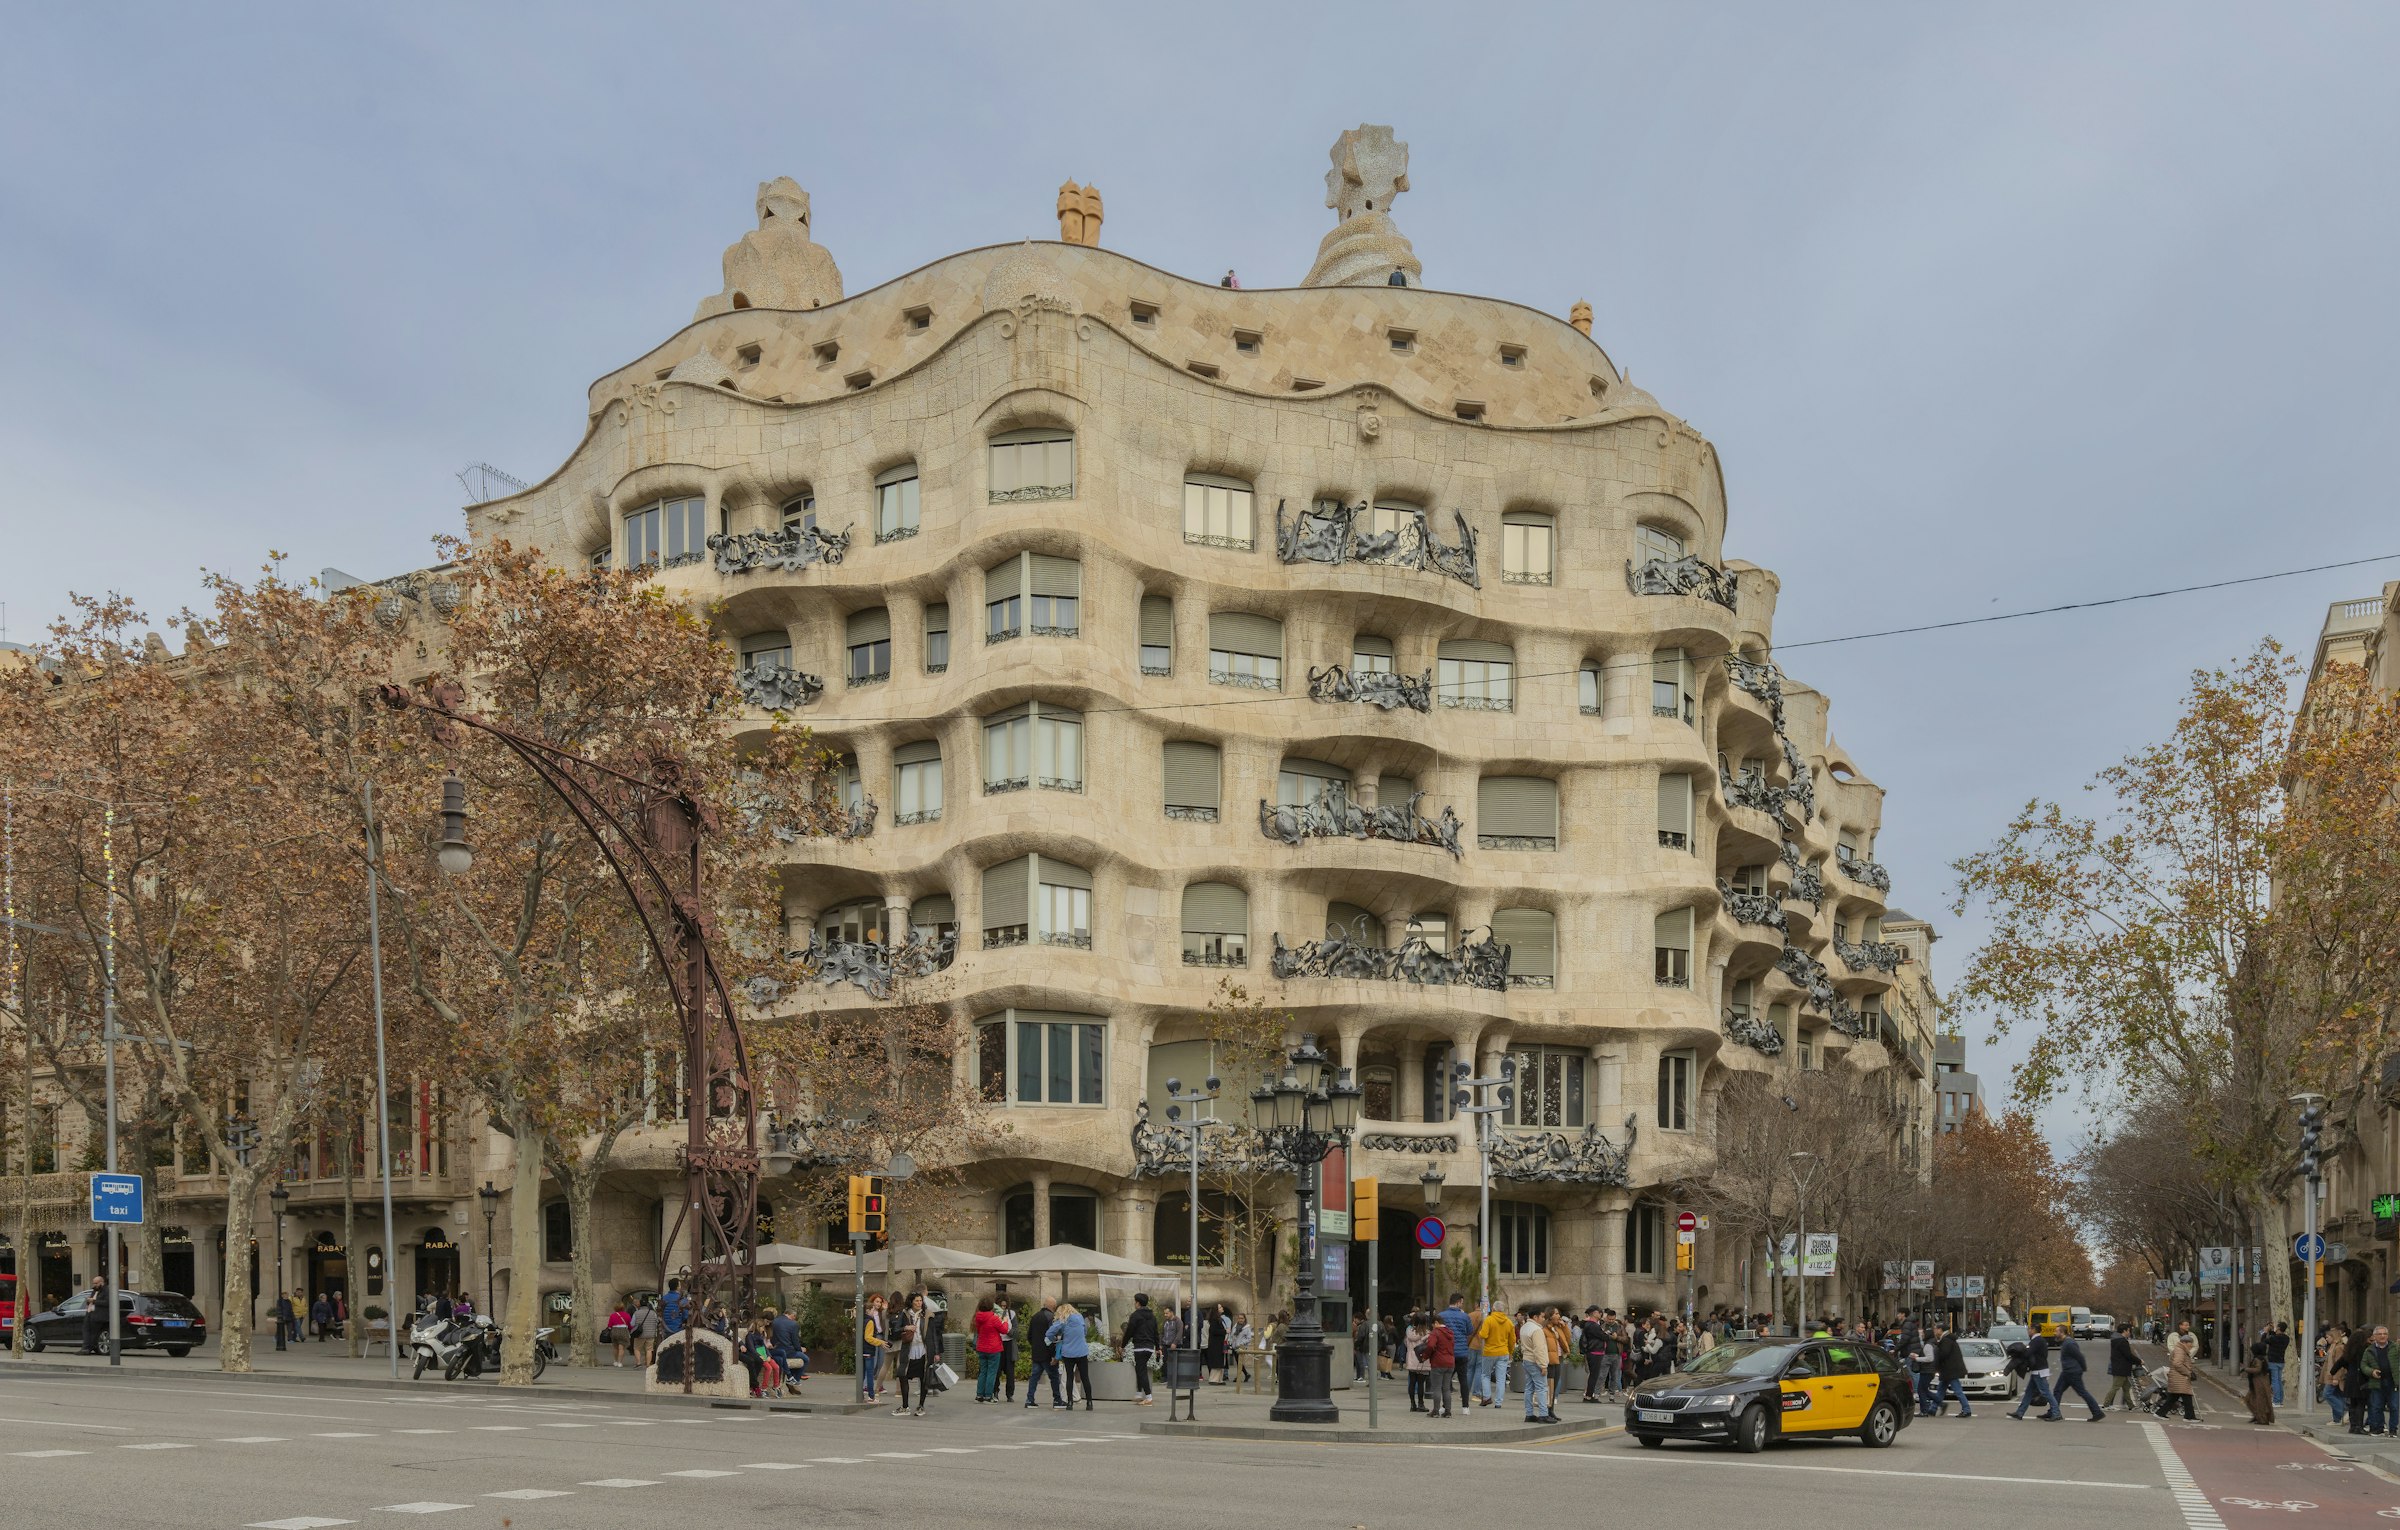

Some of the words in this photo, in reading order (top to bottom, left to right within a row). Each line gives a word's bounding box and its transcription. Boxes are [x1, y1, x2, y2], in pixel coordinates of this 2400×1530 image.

[109, 1205, 128, 1215] taxi
[1812, 1240, 1831, 1248] CURSA
[1810, 1247, 1833, 1256] NASSOS
[1643, 1412, 1658, 1421] 2068
